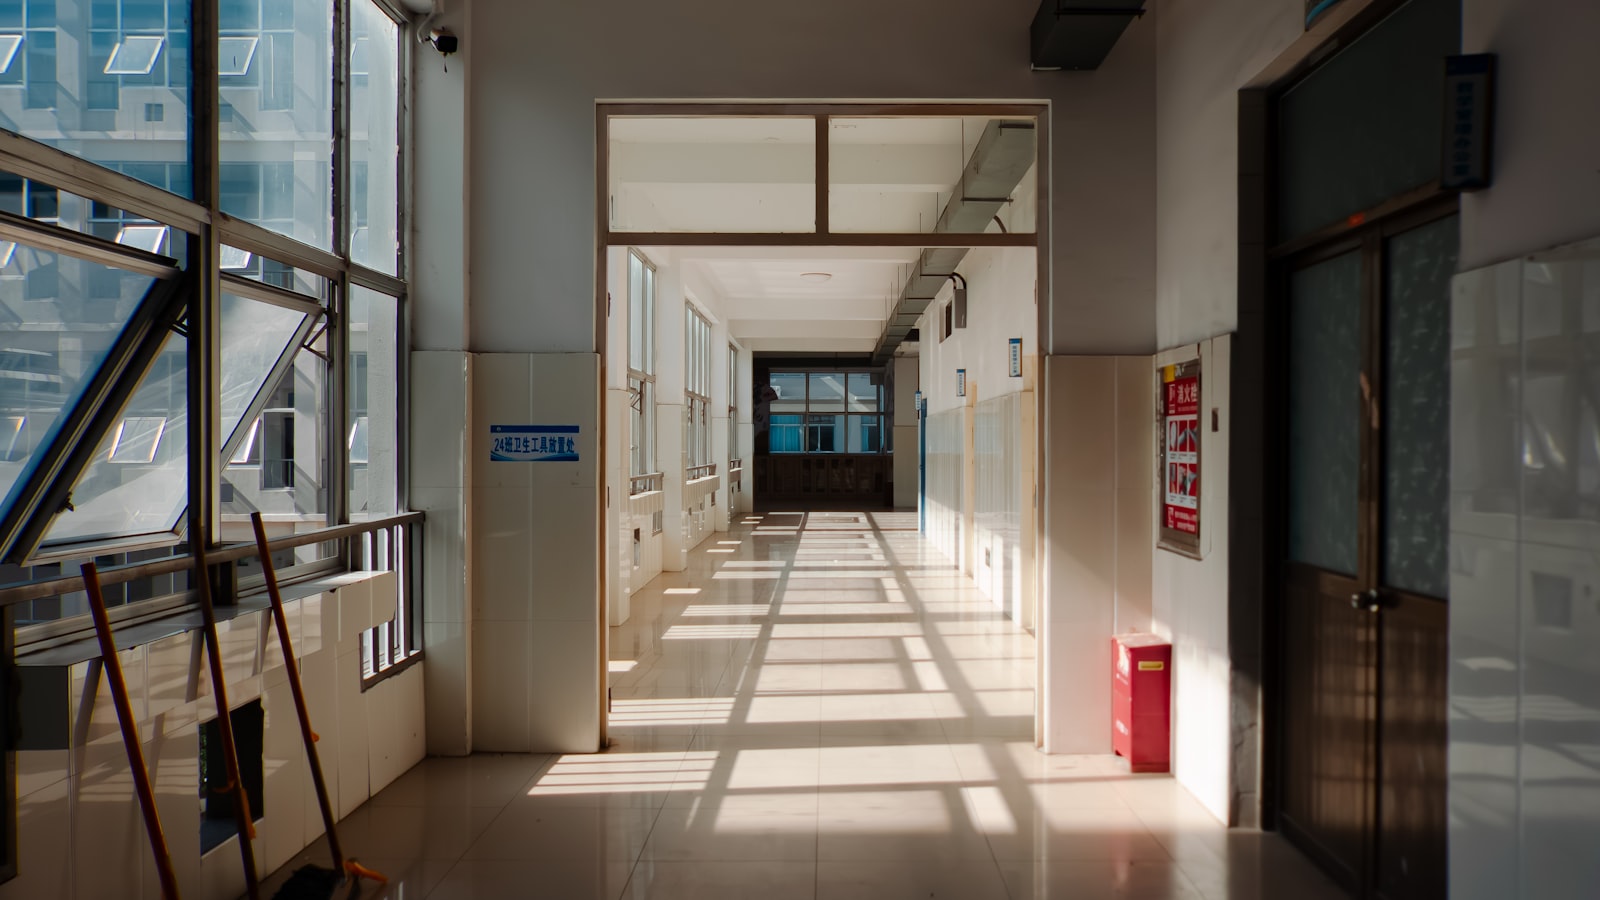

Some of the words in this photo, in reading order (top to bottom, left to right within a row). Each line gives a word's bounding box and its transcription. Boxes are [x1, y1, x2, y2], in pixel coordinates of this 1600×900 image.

[494, 436, 575, 453] 24班卫生工具放置处
